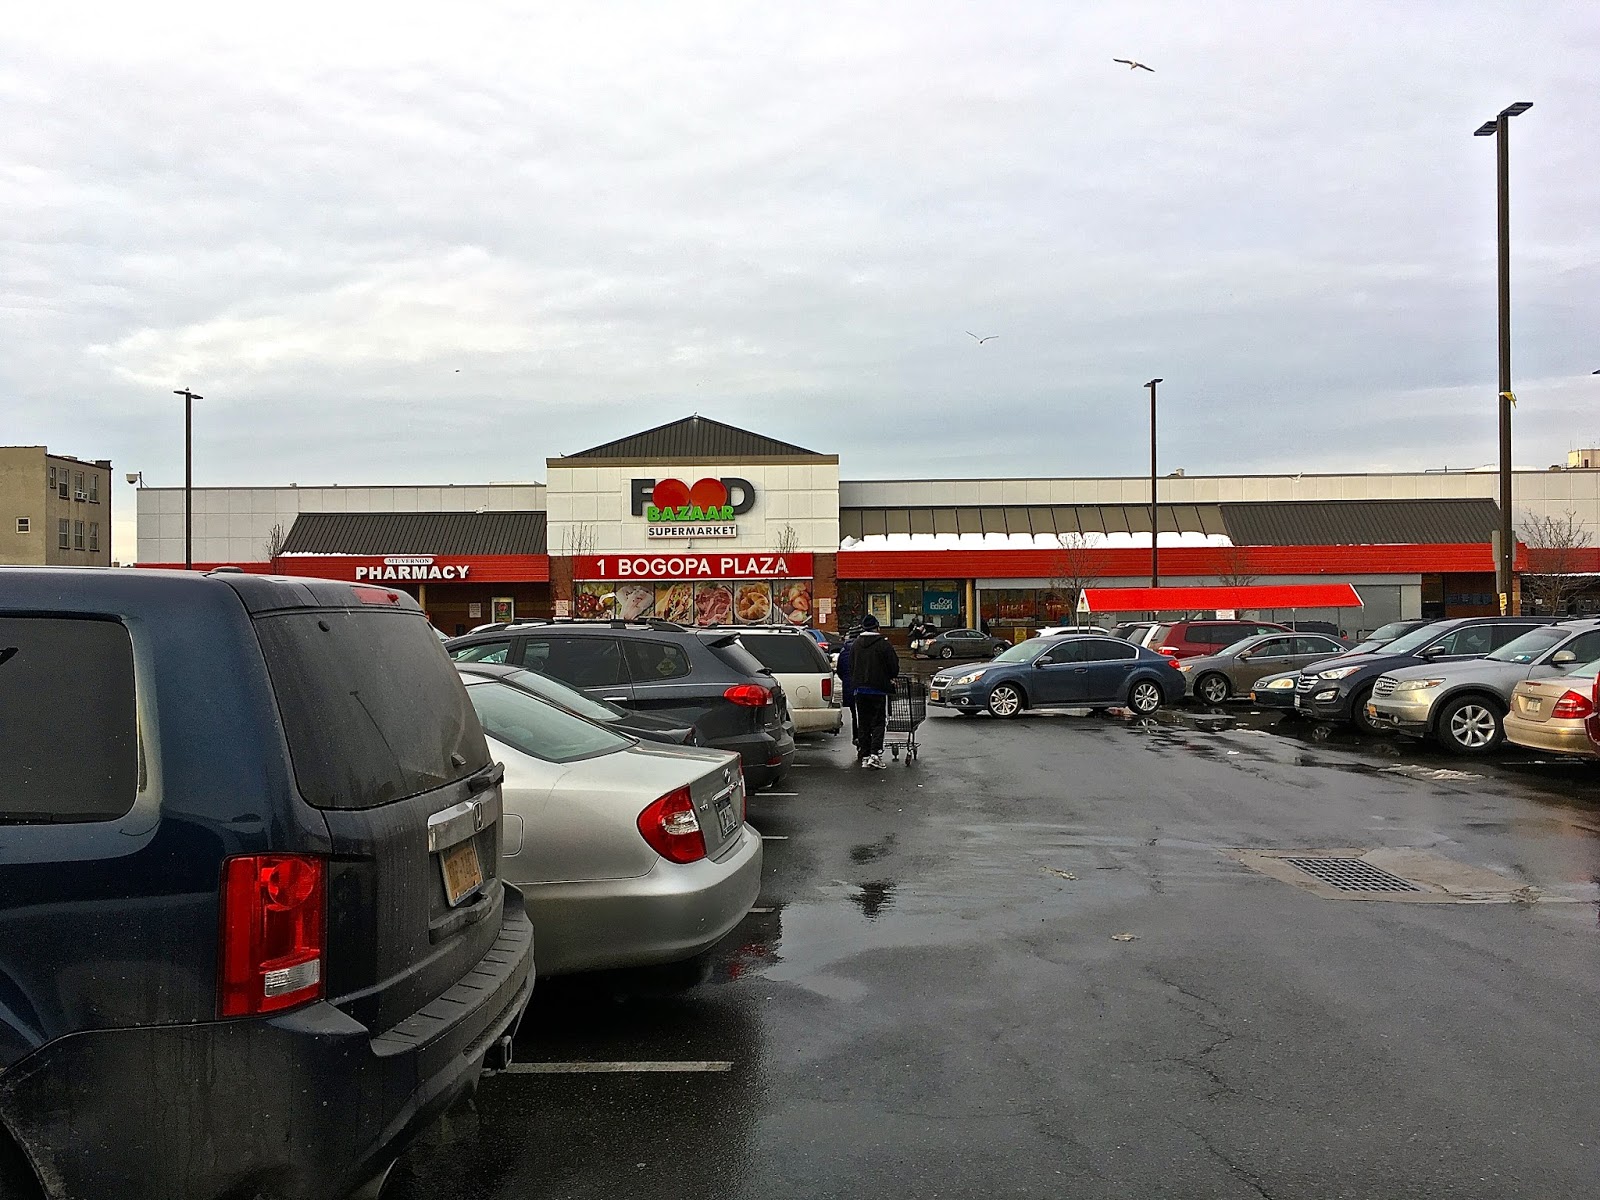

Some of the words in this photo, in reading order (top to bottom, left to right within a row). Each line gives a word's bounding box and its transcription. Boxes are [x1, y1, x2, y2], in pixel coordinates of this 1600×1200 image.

[631, 477, 756, 516] FOOD
[647, 505, 735, 522] BAZAAR
[648, 526, 735, 536] SUPERMARKET
[355, 565, 469, 580] PHARMACY
[596, 559, 605, 576] 1
[618, 558, 711, 576] BOGOPA
[720, 557, 789, 575] PLAZA
